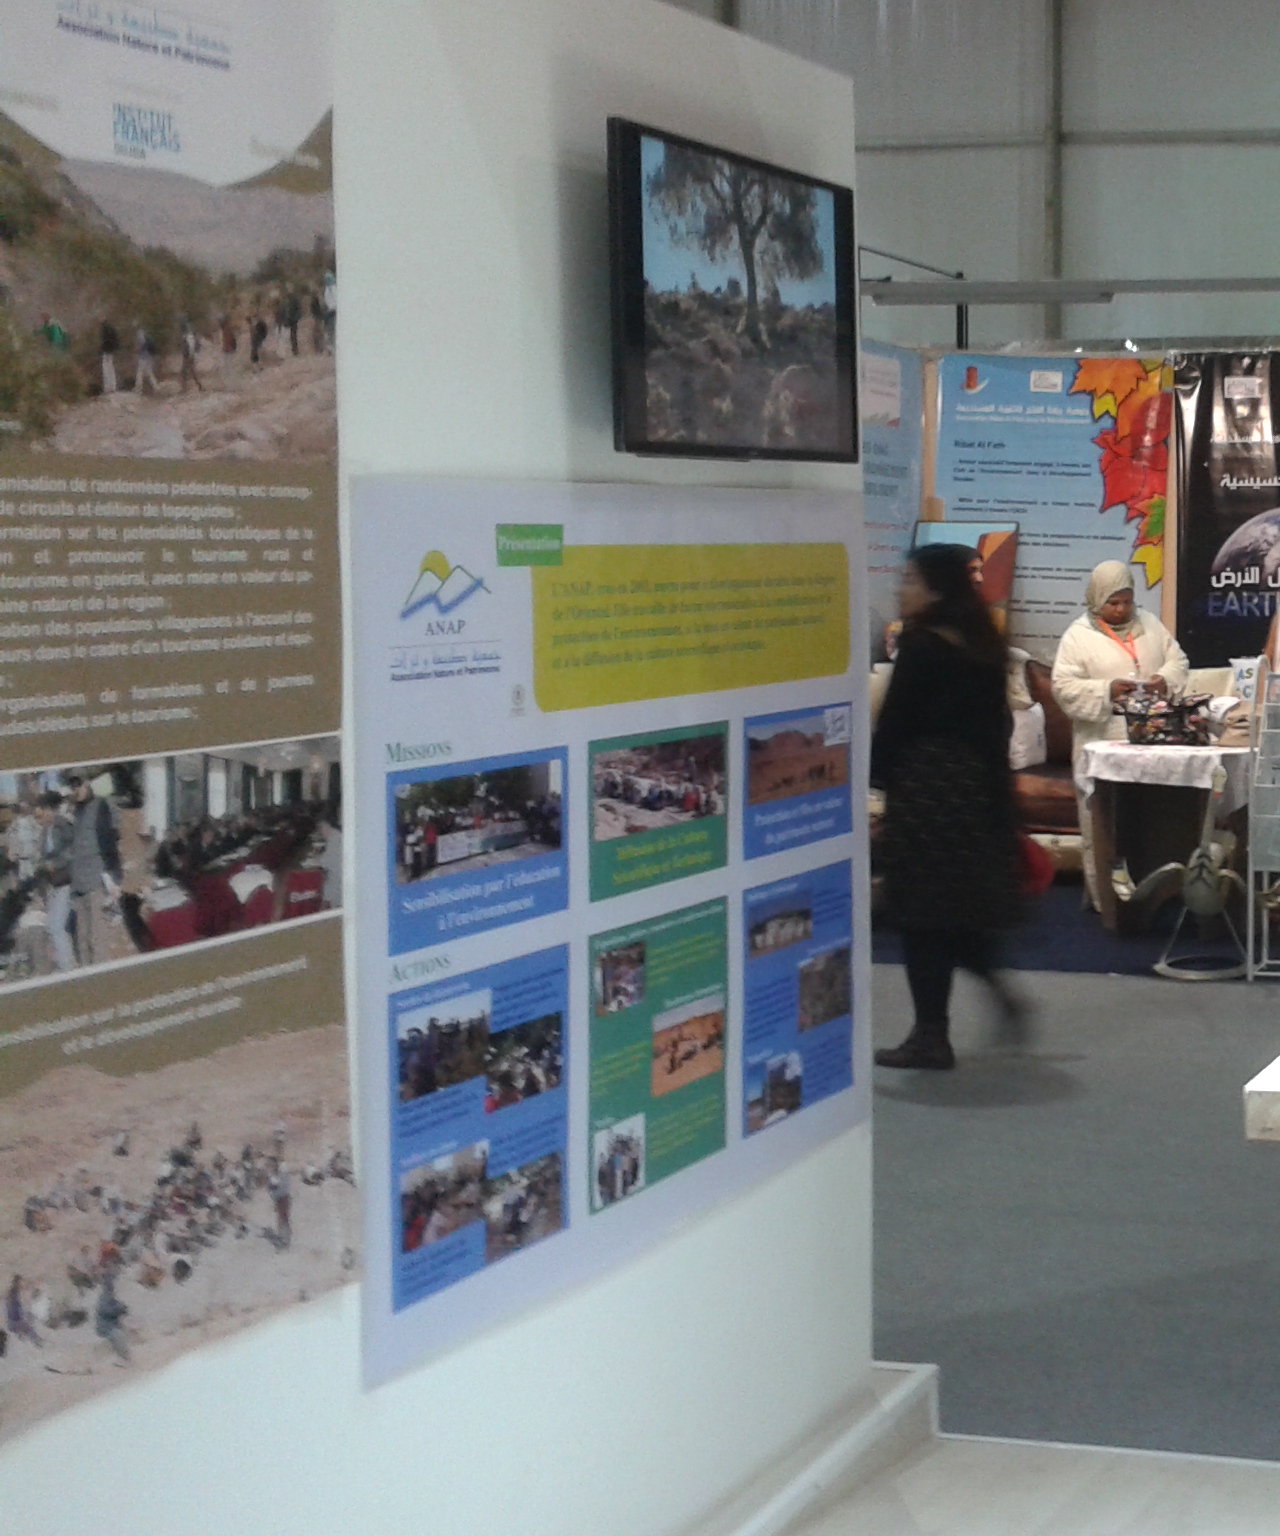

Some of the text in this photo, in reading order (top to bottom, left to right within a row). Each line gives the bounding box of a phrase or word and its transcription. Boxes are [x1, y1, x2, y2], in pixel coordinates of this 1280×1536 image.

[18, 501, 75, 516] circuits
[67, 527, 90, 540] sur
[96, 525, 118, 541] les
[31, 597, 83, 612] naturel
[424, 618, 467, 637] ANAP
